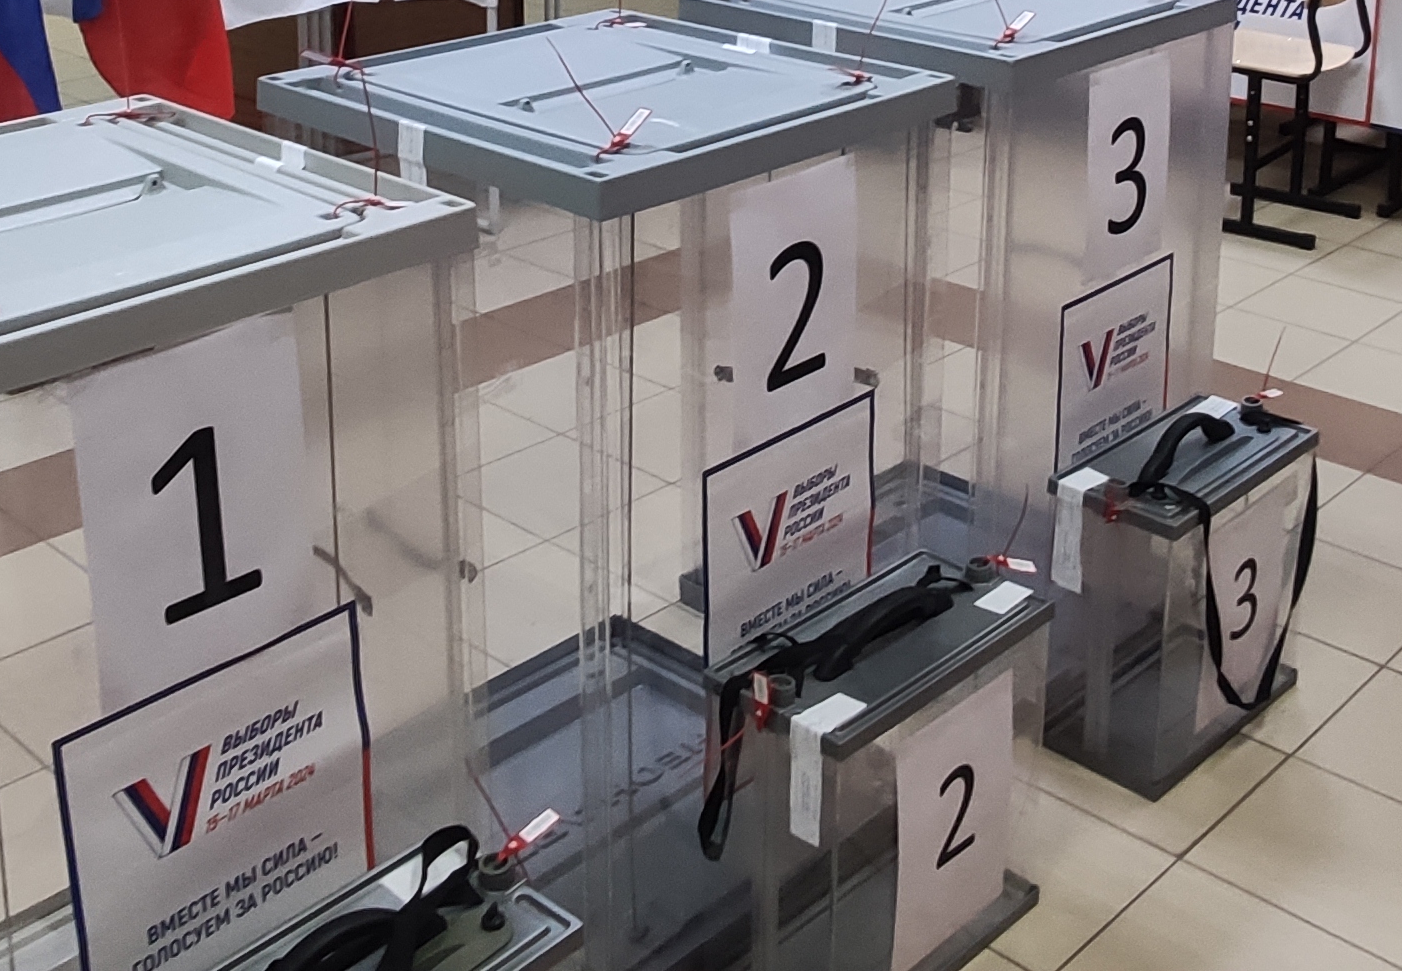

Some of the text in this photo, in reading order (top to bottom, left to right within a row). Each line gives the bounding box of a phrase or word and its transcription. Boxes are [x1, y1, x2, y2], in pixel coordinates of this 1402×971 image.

[1107, 116, 1148, 235] 3
[767, 240, 827, 393] 2
[787, 473, 851, 520] ПРЕЗИДЕНТА
[792, 462, 839, 500] ВЫБОРЫ
[149, 425, 263, 626] 1
[783, 505, 825, 541] РОССИИ
[740, 600, 784, 638] ВМЕСТЕ
[784, 588, 805, 611] МЫ
[806, 571, 834, 599] СИЛА
[1229, 556, 1258, 641] 3
[215, 710, 323, 784] ПРЕЗИДЕНТА
[220, 699, 299, 756] ВЫБОРЫ
[209, 756, 281, 811] РОССИИ
[241, 778, 285, 815] МАРТА
[935, 763, 976, 871] 2
[147, 886, 220, 946] ВМЕСТЕ
[223, 864, 258, 900] МЫ
[261, 836, 308, 878] СИЛА
[235, 892, 258, 919] ЗА
[260, 840, 339, 904] РОССИЮ!
